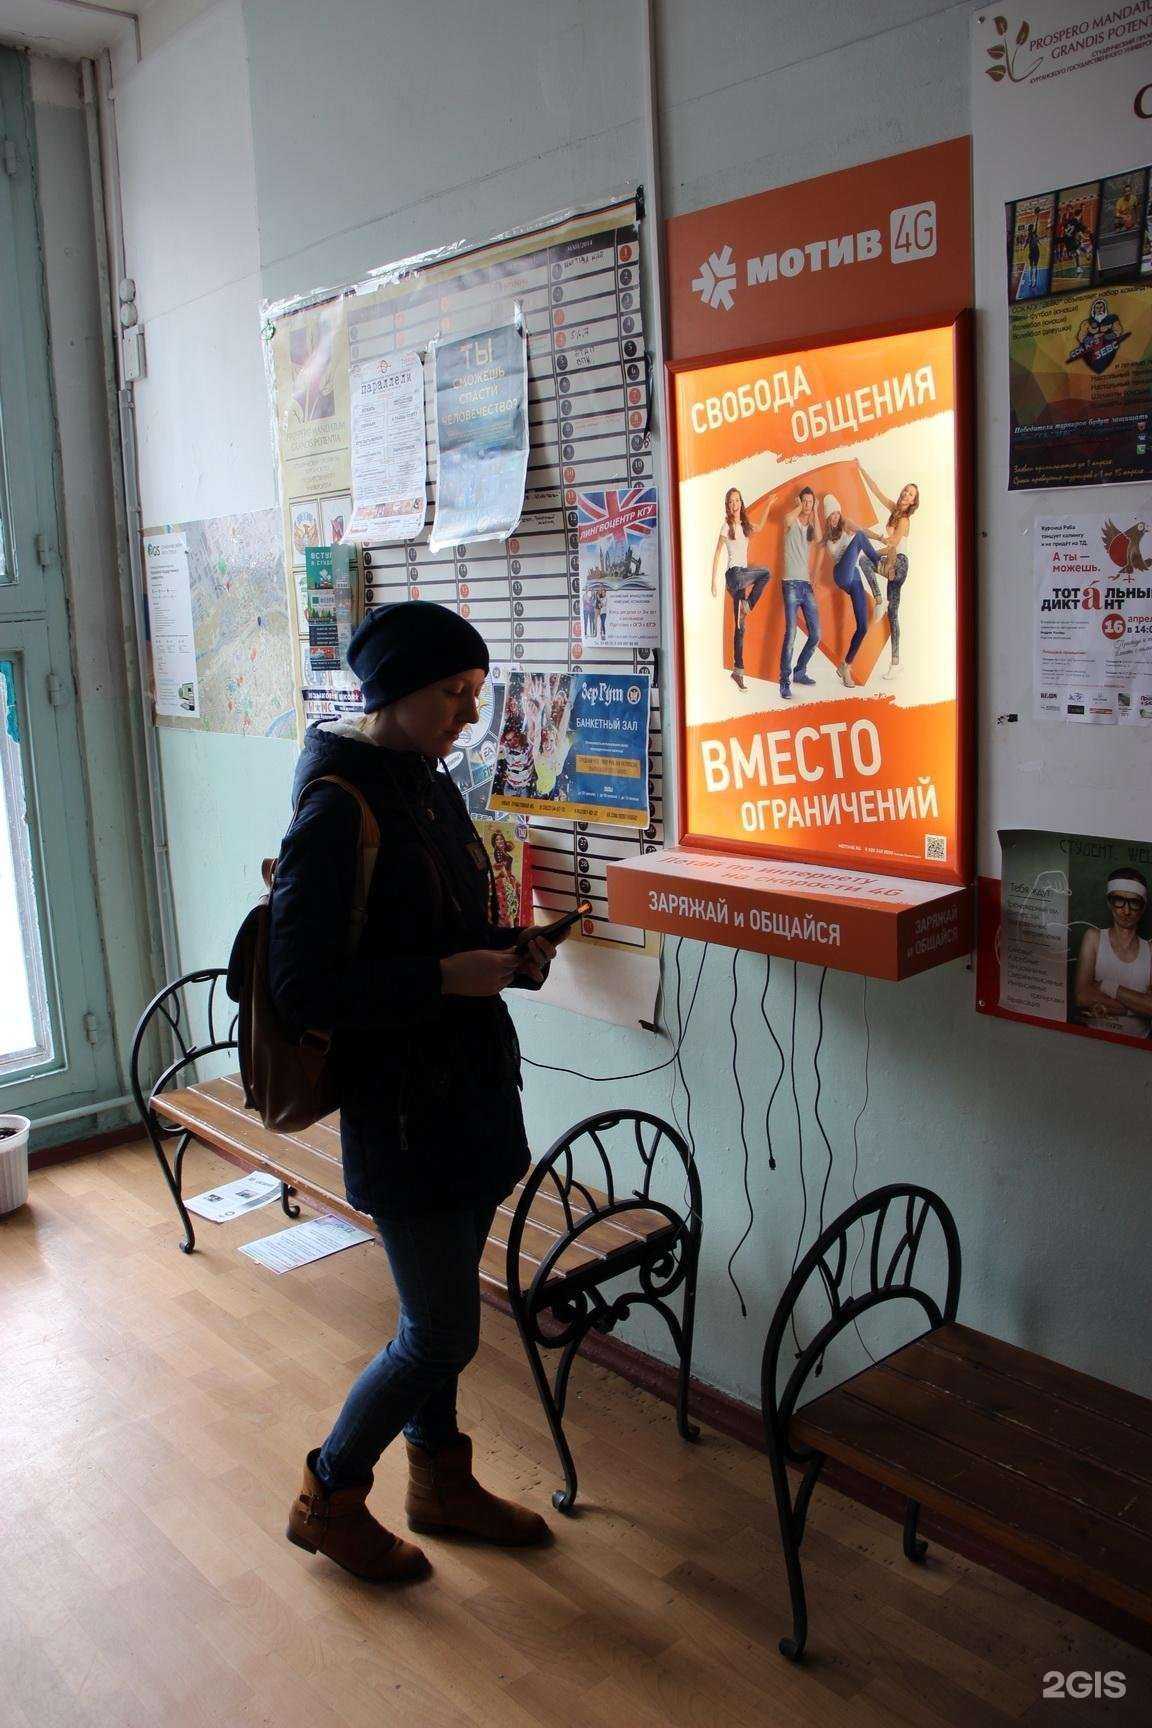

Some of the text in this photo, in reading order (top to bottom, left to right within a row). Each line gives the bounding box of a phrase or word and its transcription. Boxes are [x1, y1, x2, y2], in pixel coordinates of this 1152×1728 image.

[1030, 21, 1090, 51] PROSPERO
[1051, 31, 1105, 59] GRANDIS
[747, 209, 933, 286] МОТИВ 4G
[459, 338, 493, 369] ТЫ
[360, 372, 412, 394] параллели
[453, 367, 505, 389] СМОЖЕШЬ
[458, 387, 500, 405] СПАСТИ
[690, 365, 812, 434] СВОБОДА
[791, 364, 937, 443] ОБЩЕНИЯ
[441, 398, 518, 426] ЧЕЛОВЕЧЕСТВО?
[580, 511, 636, 540] ЛИНГВОЦЕНТР
[637, 504, 653, 517] КГУ
[1052, 552, 1077, 562] А ты
[1052, 564, 1101, 573] можешь.
[1104, 620, 1124, 634] 16
[576, 717, 638, 731] БАНКЕТНЫЙ ЗАЛ
[700, 719, 882, 792] ВМЕСТО
[740, 776, 939, 832] ОГРАНИЧЕНИЙ
[648, 890, 841, 946] ЗАРЯЖАЙ и ОБЩАЙСЯ
